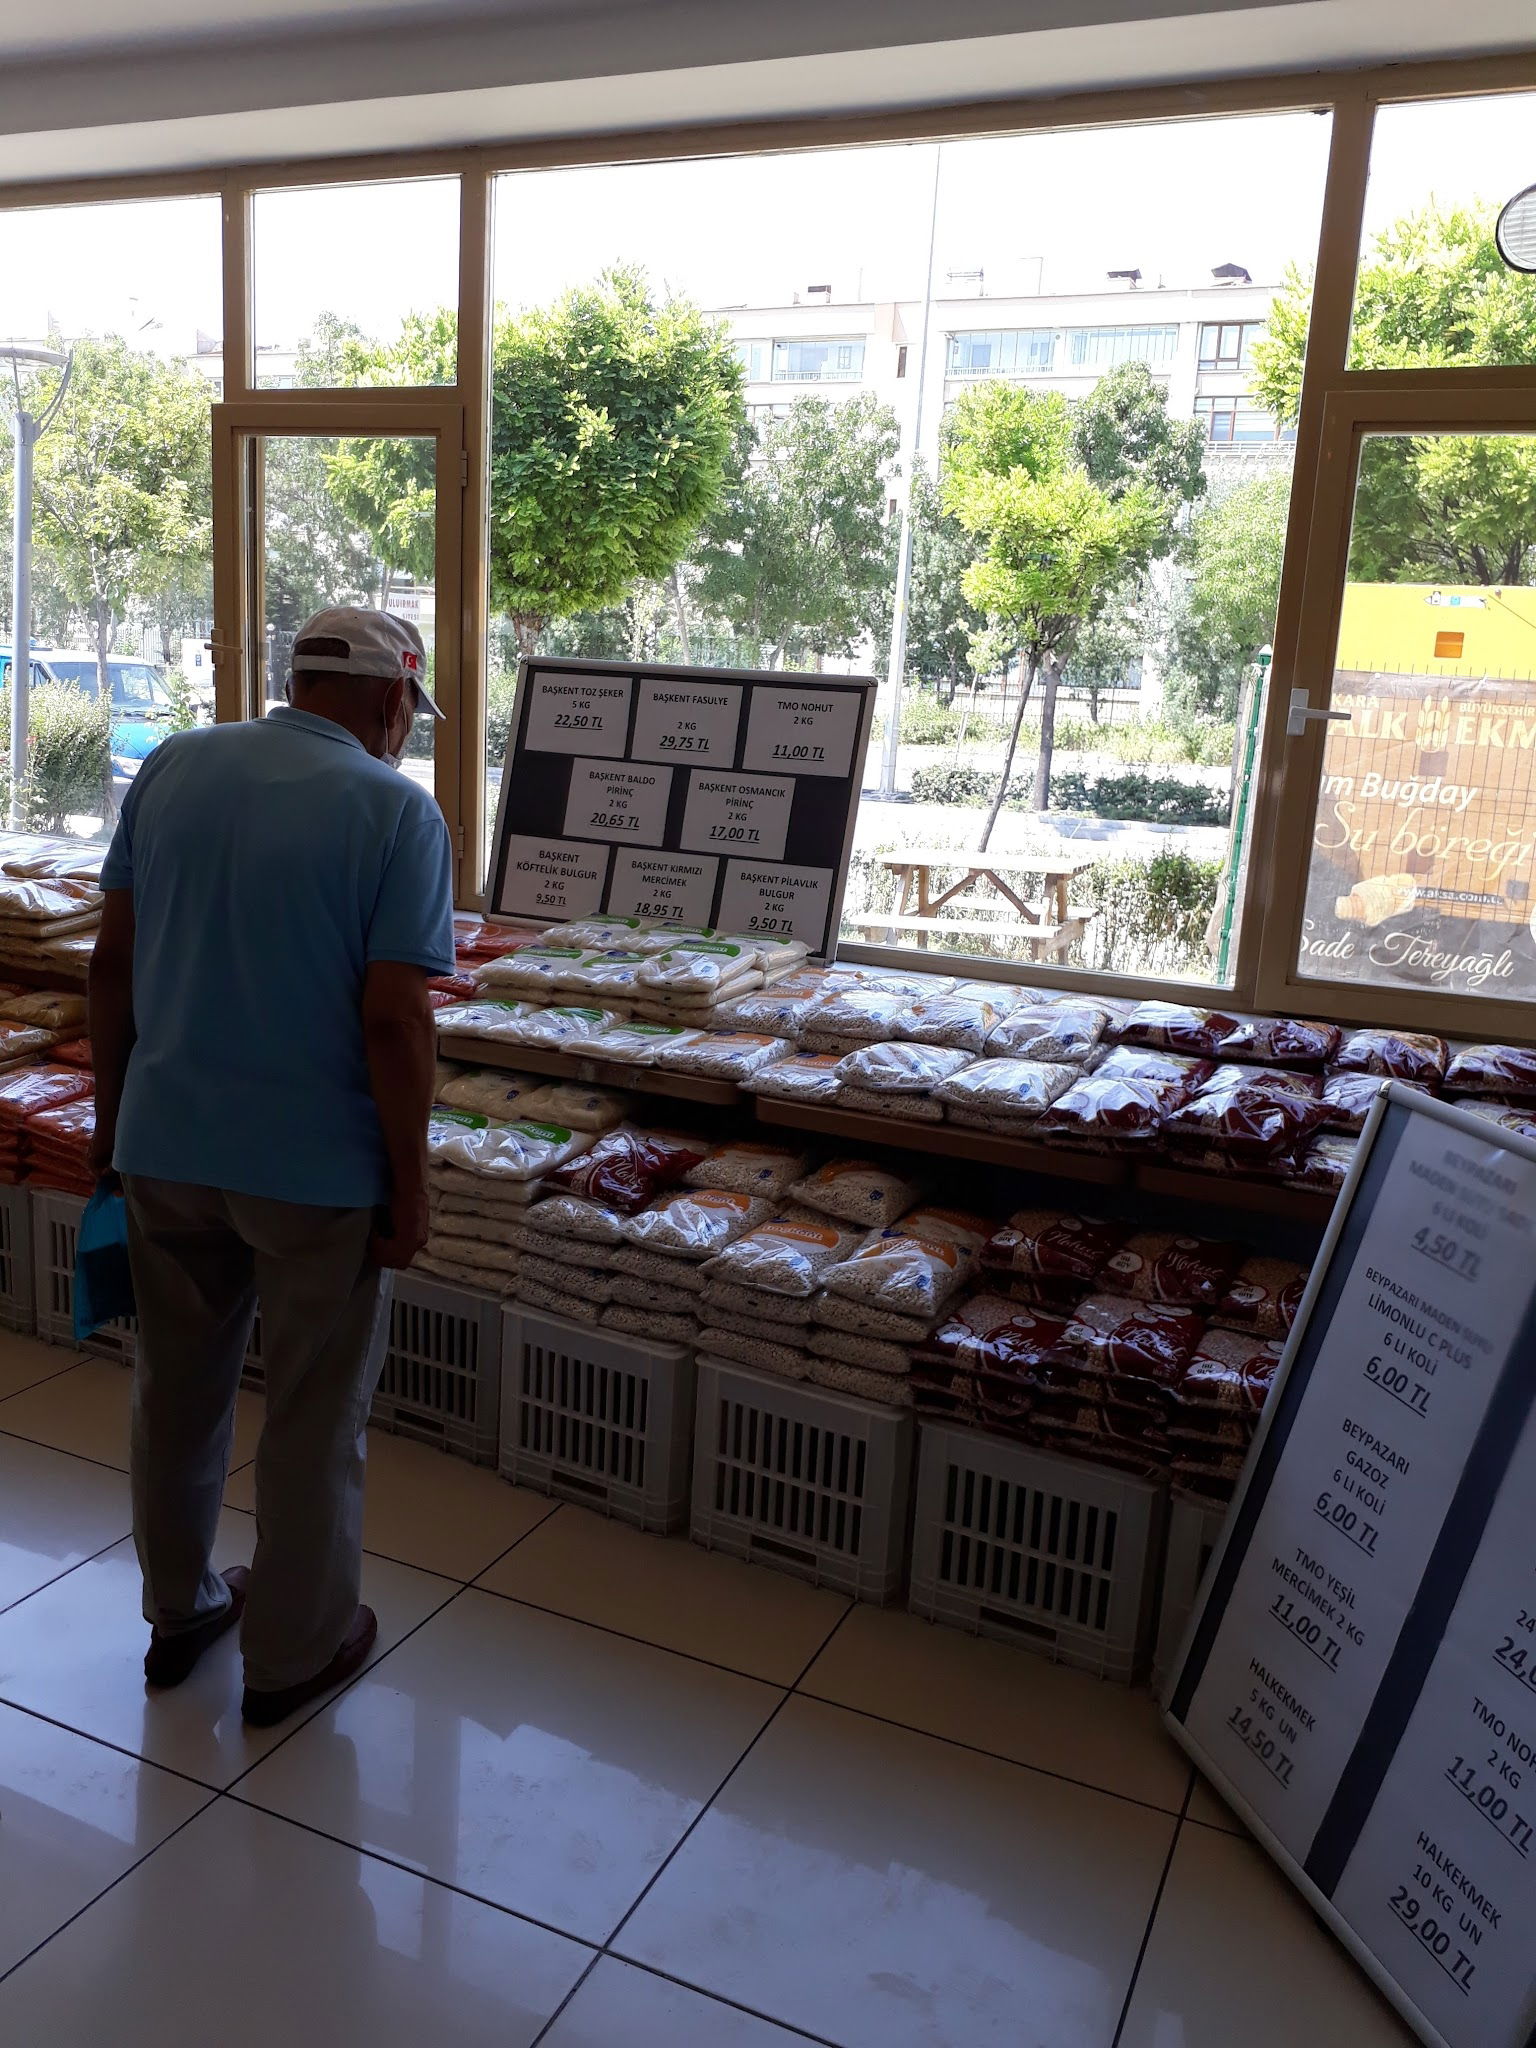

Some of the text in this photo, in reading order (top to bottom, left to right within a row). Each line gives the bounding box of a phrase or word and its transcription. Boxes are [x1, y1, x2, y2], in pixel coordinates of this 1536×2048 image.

[542, 686, 624, 698] BAŞKENT TOZ ŞEKER
[653, 693, 728, 705] BAŞKENT FASULYE
[572, 700, 577, 708] 5
[778, 701, 834, 712] TMO NOHUT
[554, 714, 603, 728] 22,50 TL
[685, 722, 696, 730] KG
[794, 716, 813, 725] 2 KG
[659, 736, 710, 750] 29,75 TL
[773, 744, 824, 758] 11,00 TL
[589, 771, 655, 784] BAŞKENT BALDO
[606, 785, 634, 797] PİRİNÇ
[699, 783, 786, 797] BAŞKENT OSMANCIK
[1360, 772, 1478, 813] Buğday
[726, 798, 754, 809] PİRİNÇ
[590, 812, 640, 828] 20,65 TL
[728, 812, 747, 821] 2 KG
[710, 825, 760, 841] 17,00 TL
[1314, 800, 1536, 881] Su böreği
[539, 850, 580, 863] BAŞKENT
[517, 861, 597, 880] KÖFTELİK BULGUR
[632, 861, 703, 875] BAŞKENT KIRMIZI
[544, 880, 565, 890] 2 KG
[642, 875, 687, 886] MERCİMEK
[741, 873, 818, 888] BAŞKENT PİLAVLIK
[536, 893, 566, 905] 9,50 TL
[660, 890, 672, 898] KG
[759, 888, 795, 899] BULGUR
[635, 902, 684, 917] 18,95 TL
[772, 904, 784, 912] KG
[749, 916, 794, 932] 9,50 TL
[1369, 932, 1514, 986] Tereyağlı
[1414, 1227, 1482, 1277] 4,50 TL
[1365, 1267, 1420, 1308] BEYPAZARI
[1420, 1301, 1462, 1333] MADEN
[1368, 1293, 1472, 1369] LİMONLU C PLUS
[1384, 1332, 1438, 1376] 6 LI KOLİ
[1366, 1356, 1432, 1413] 6,00 TL
[1342, 1417, 1410, 1475] BEYPAZARI
[1346, 1450, 1390, 1490] GAZOZ
[1333, 1469, 1386, 1516] 6 LI KOLİ
[1316, 1492, 1379, 1552] 6,00 TL
[1295, 1547, 1356, 1610] TMO YEŞİL
[1272, 1558, 1365, 1647] MERCİMEK 2 KG
[1272, 1594, 1342, 1668] 11,00 TL
[1249, 1657, 1316, 1732] HALKEKMEK
[1250, 1688, 1298, 1744] 5 KG UN
[1473, 1697, 1505, 1737] TMO
[1229, 1706, 1294, 1784] 14,50 TL
[1487, 1749, 1522, 1790] 2 KG
[1447, 1756, 1533, 1852] 11,00 TL
[1416, 1831, 1502, 1930] HALKEKMEK
[1412, 1864, 1483, 1945] 10 KG UN
[1390, 1885, 1476, 1990] 29,00 TL
